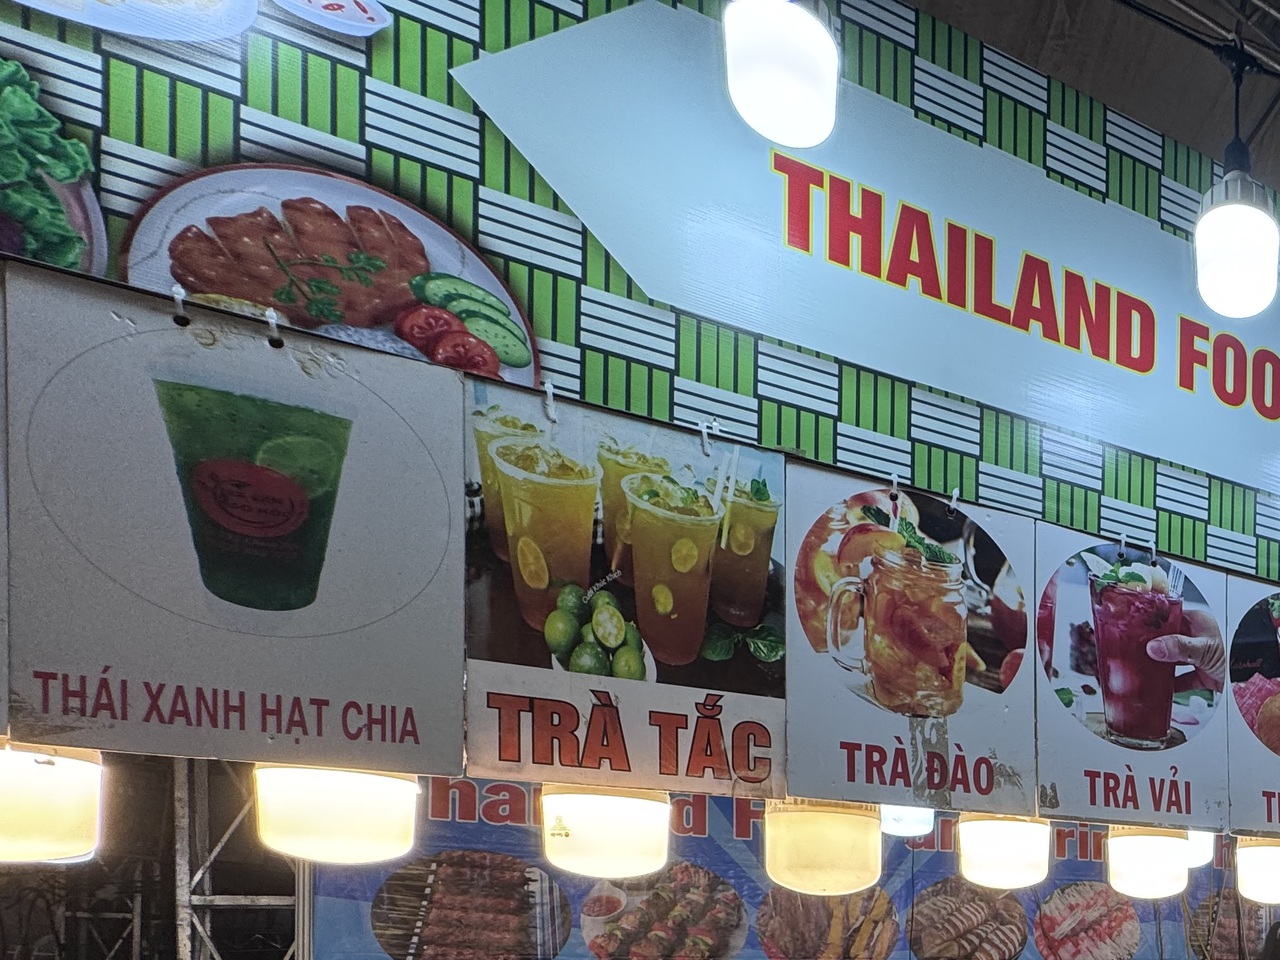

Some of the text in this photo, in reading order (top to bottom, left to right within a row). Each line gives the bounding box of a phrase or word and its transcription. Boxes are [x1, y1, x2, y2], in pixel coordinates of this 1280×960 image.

[770, 148, 1157, 375] THAILAND
[32, 666, 420, 745] THÁI XANH HẠT CHIA
[487, 690, 772, 783] TRÀ TẮC
[839, 735, 995, 795] TRÀ ĐÀO
[1084, 765, 1192, 815] TRÀ VẢI
